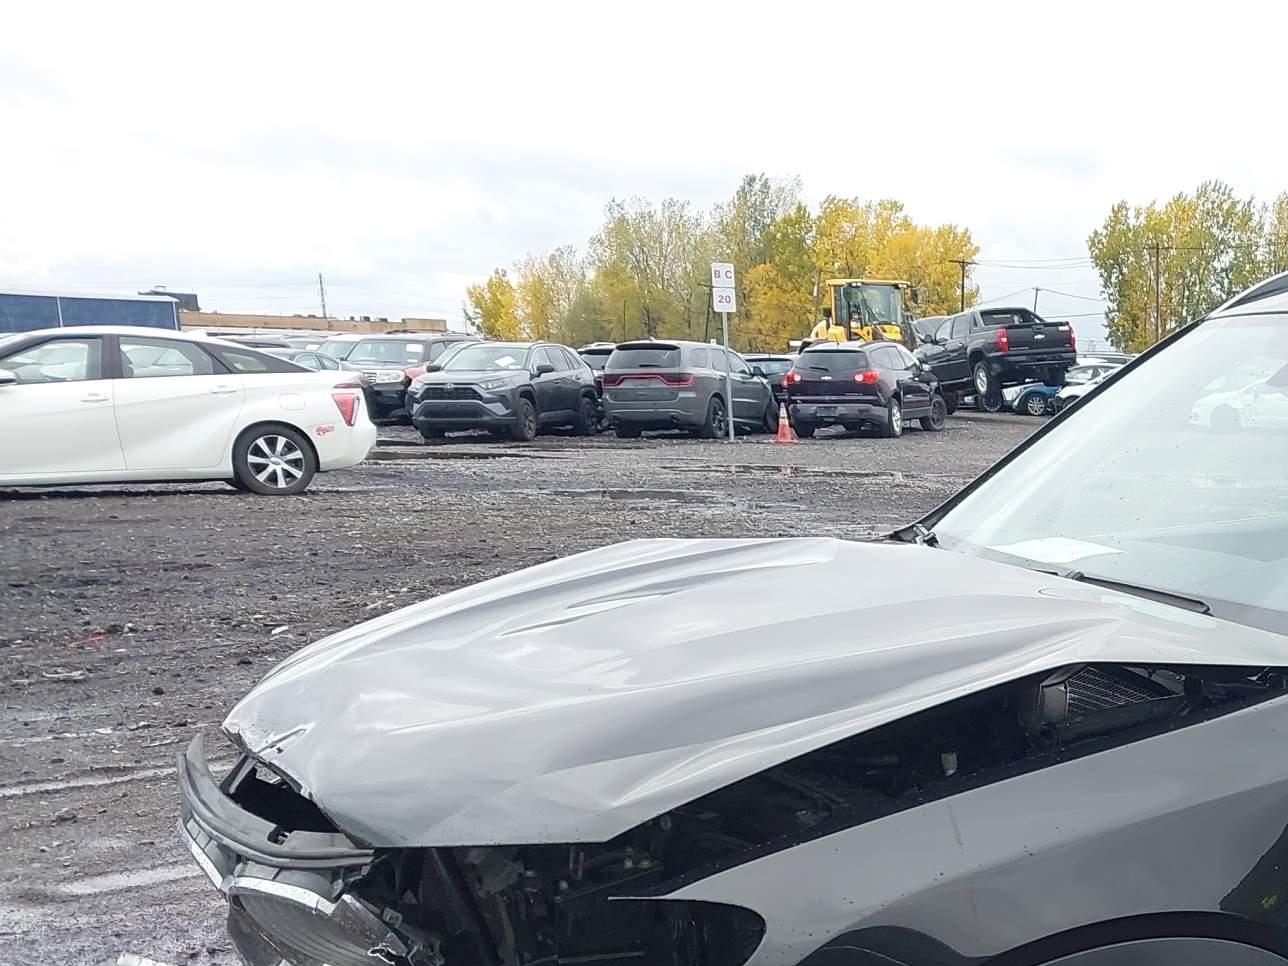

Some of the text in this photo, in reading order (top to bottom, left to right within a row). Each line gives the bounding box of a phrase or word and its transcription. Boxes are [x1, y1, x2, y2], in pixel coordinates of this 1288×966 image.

[713, 269, 733, 279] B C
[718, 294, 732, 304] 20
